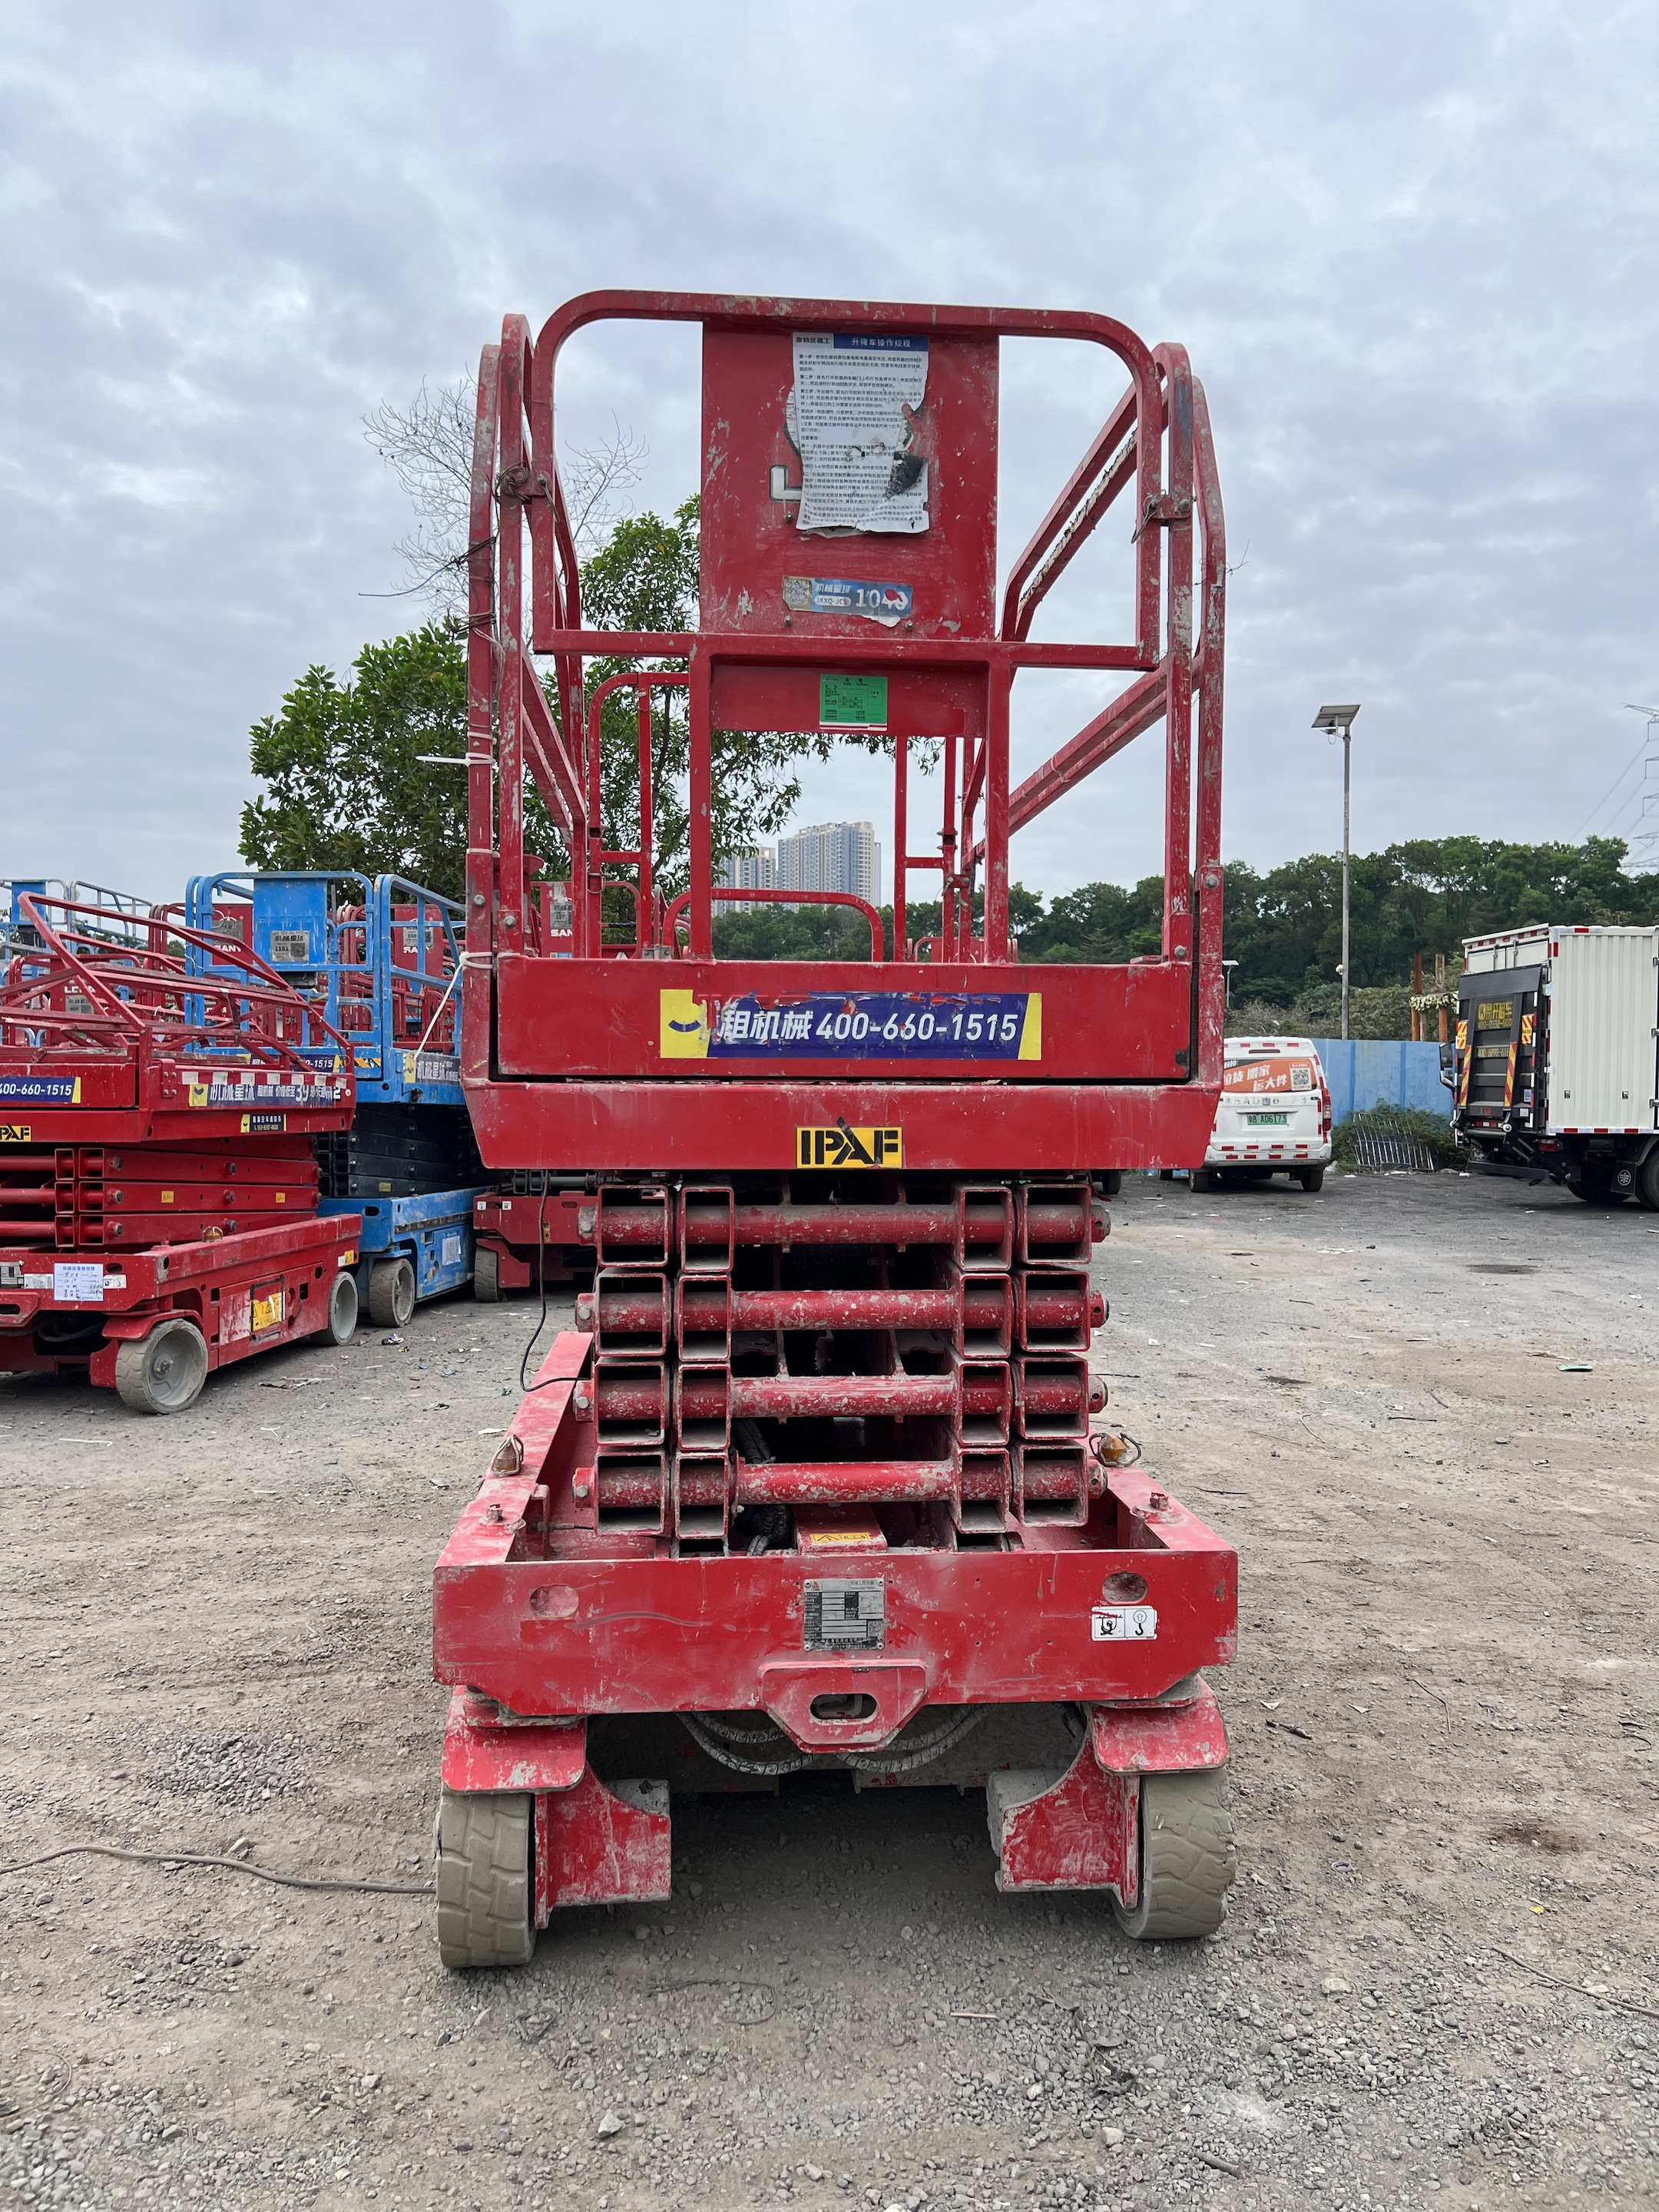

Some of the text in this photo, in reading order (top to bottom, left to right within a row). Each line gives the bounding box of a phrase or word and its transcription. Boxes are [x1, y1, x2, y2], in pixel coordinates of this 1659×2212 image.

[852, 339, 911, 348] 升降车操作规程
[816, 1012, 1018, 1041] 400-660-1515
[1253, 1074, 1287, 1092] 运大件
[801, 1116, 899, 1164] IPAF
